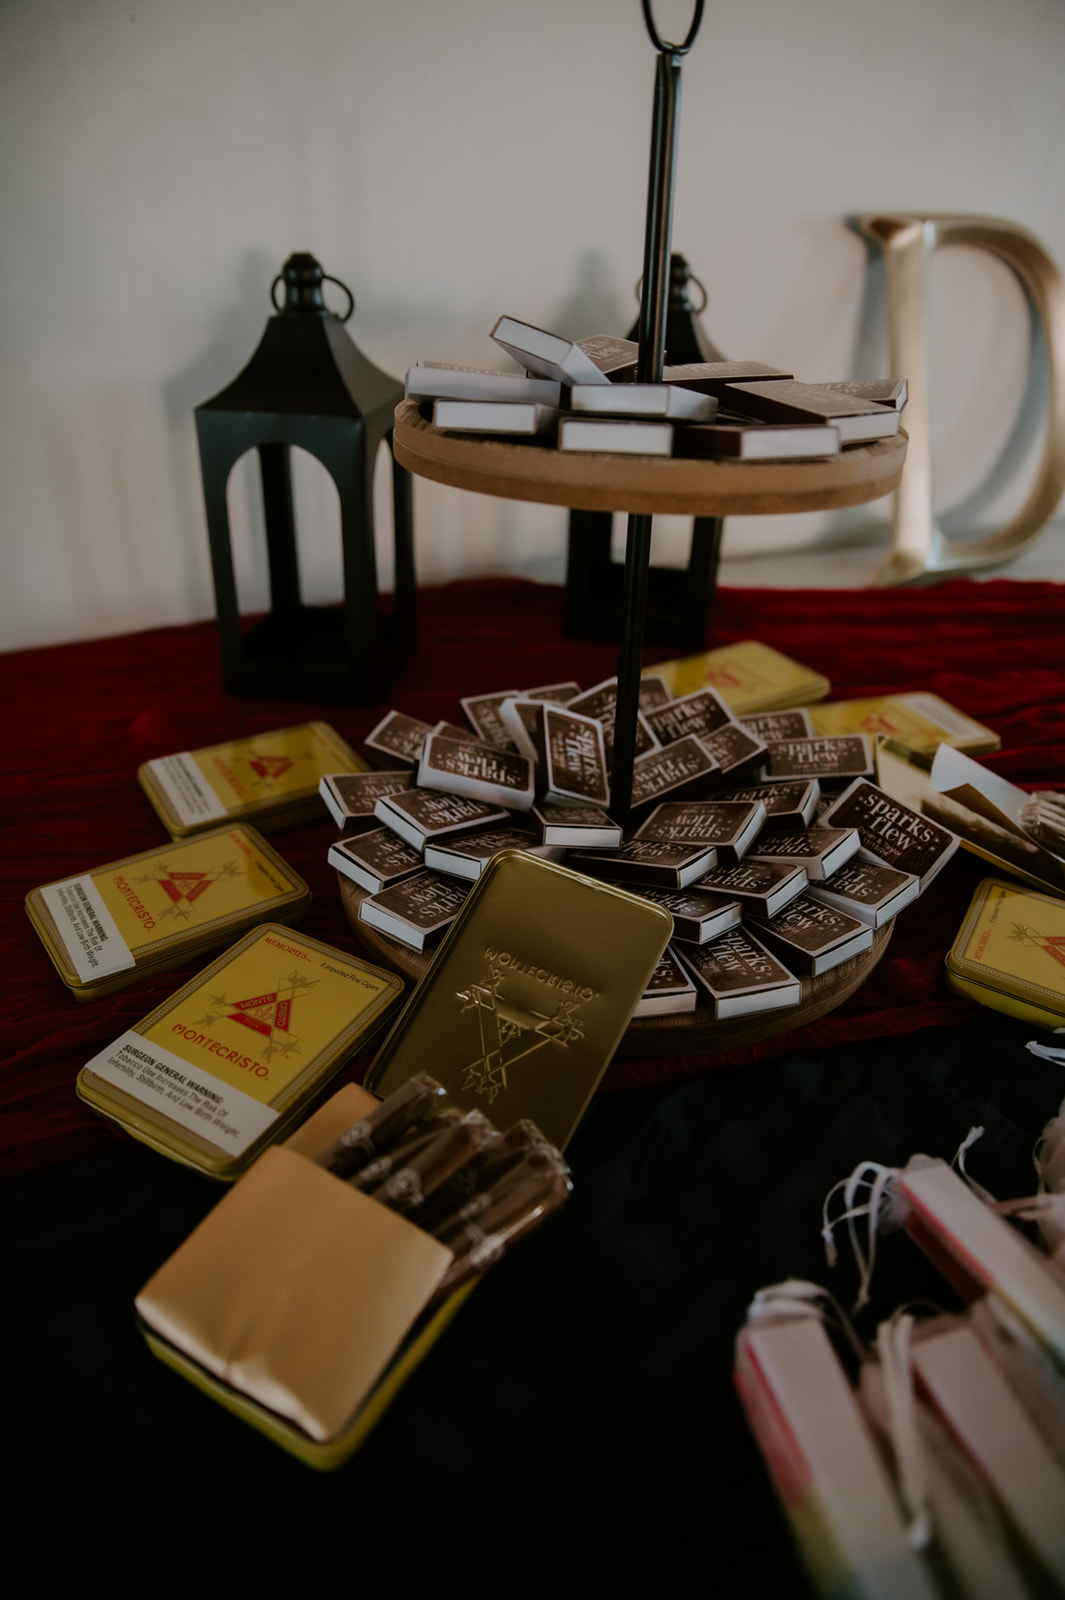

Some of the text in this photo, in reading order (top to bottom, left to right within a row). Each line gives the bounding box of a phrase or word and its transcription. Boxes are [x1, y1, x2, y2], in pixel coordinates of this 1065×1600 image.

[850, 213, 1065, 588] D
[777, 740, 848, 757] sparks
[797, 751, 838, 765] flew
[446, 757, 516, 785] sparks
[675, 814, 714, 830] flew
[864, 793, 935, 843] sparks
[656, 825, 722, 839] sparks
[869, 815, 917, 851] flew
[380, 839, 405, 852] ew
[387, 849, 420, 866] rks
[702, 876, 760, 889] spar
[824, 877, 871, 898] spar
[834, 868, 866, 883] fle
[411, 882, 453, 906] flew
[422, 886, 471, 918] parks
[780, 908, 819, 930] lew
[793, 901, 842, 926] arks
[709, 942, 747, 972] flew
[720, 931, 773, 974] sparks
[240, 995, 274, 1009] MONTE
[276, 1001, 288, 1026] CRISTO
[172, 1023, 269, 1078] MONTECRISTO
[123, 1044, 157, 1066] SURGEON
[155, 1062, 187, 1084] GENERAL
[142, 1066, 156, 1077] Use
[155, 1072, 190, 1096] Increases
